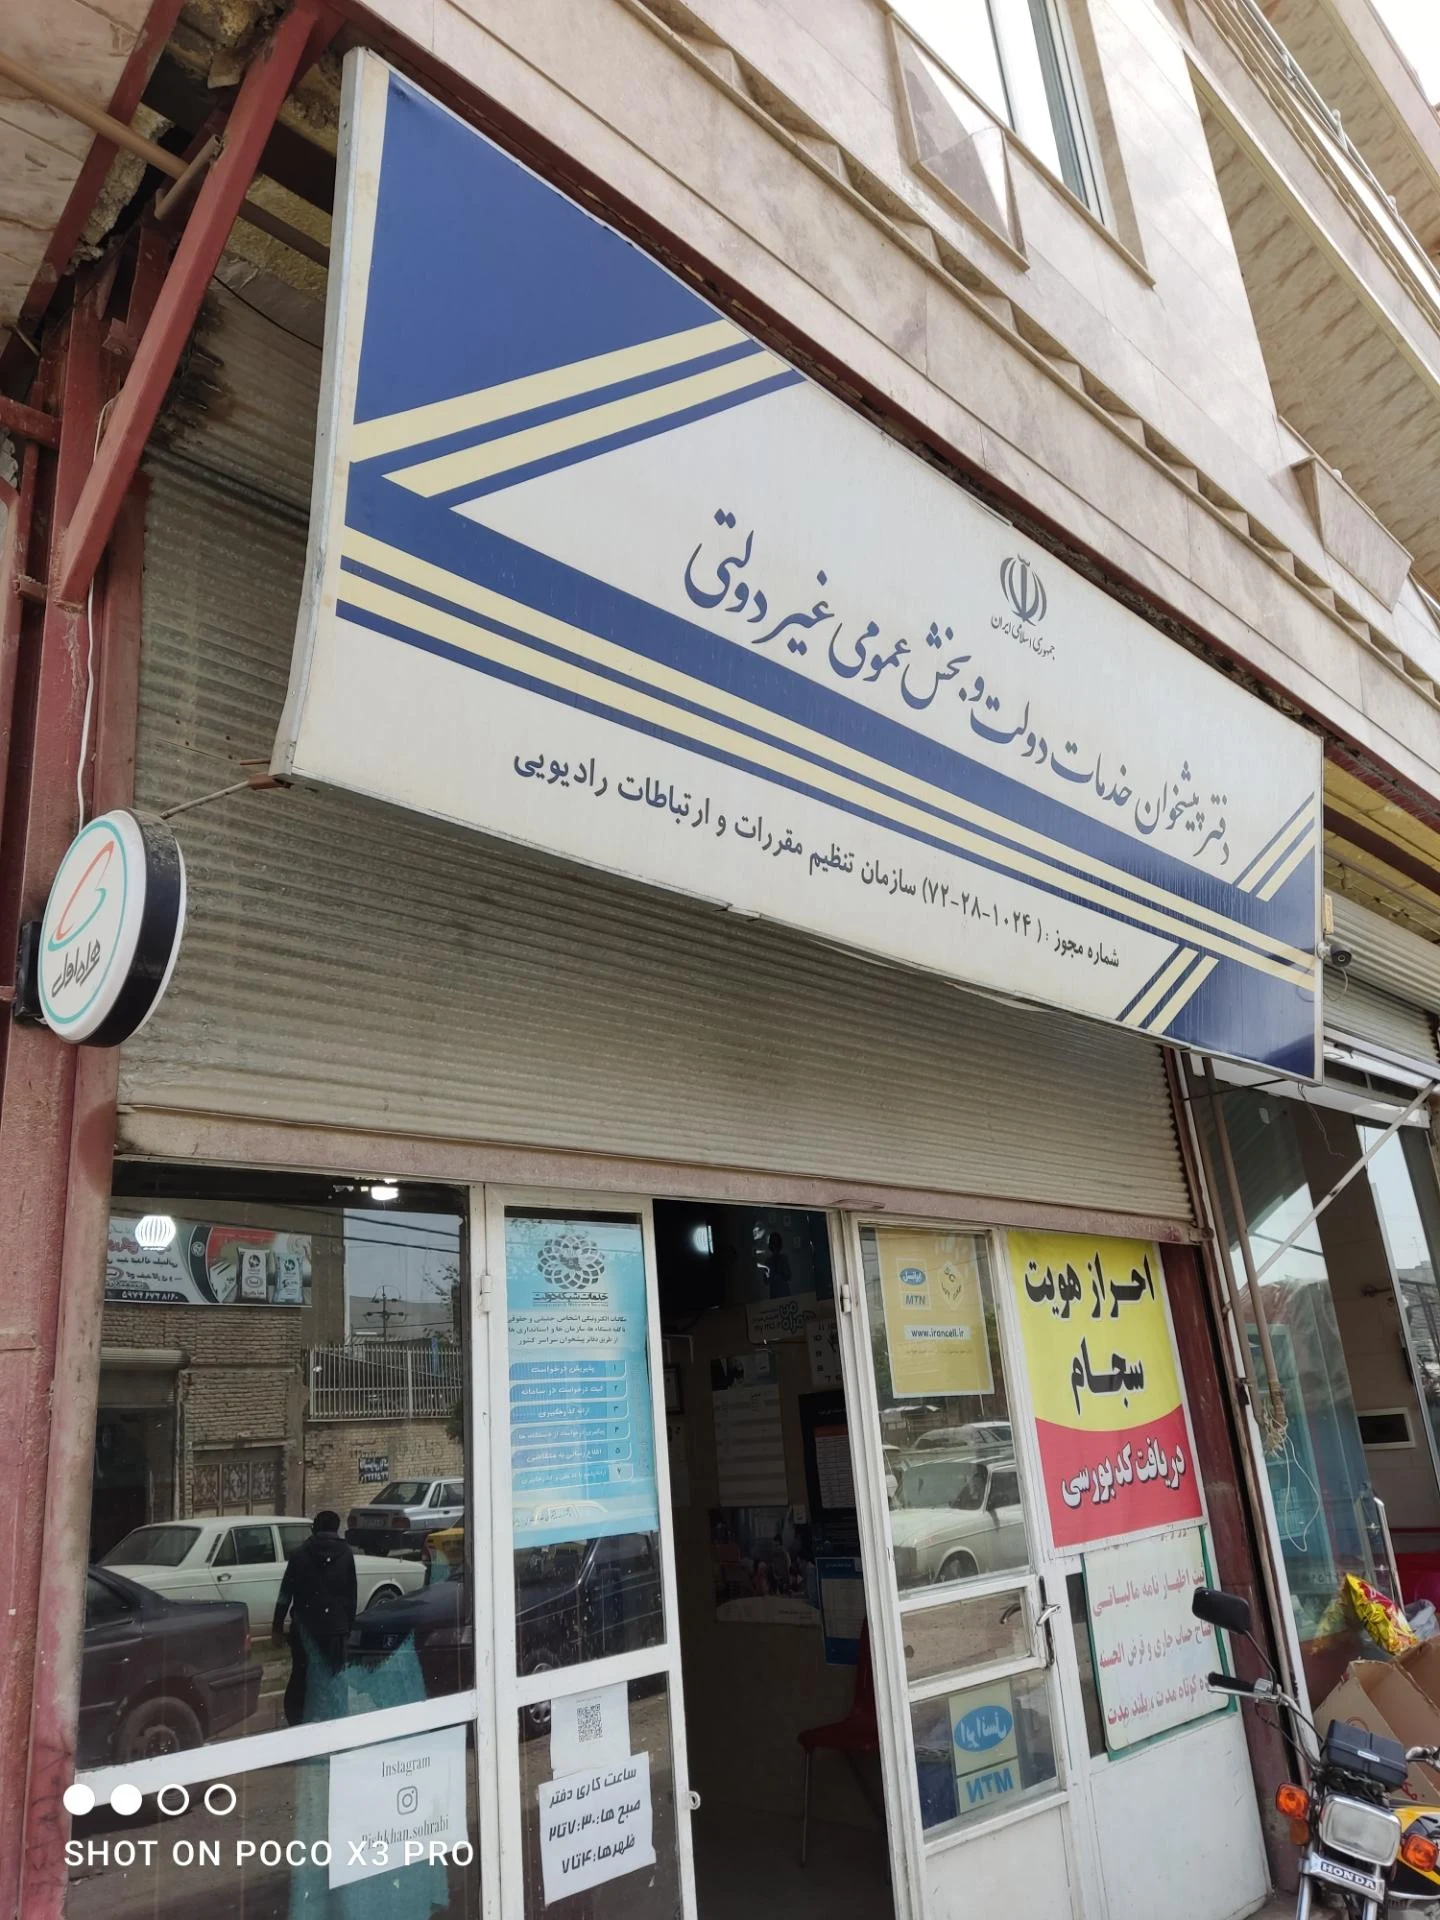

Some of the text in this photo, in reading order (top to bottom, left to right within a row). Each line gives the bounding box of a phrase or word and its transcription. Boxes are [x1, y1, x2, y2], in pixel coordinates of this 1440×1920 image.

[828, 621, 912, 683] عمومی
[991, 615, 1055, 661] جمهوری اسلامی ایران
[900, 621, 972, 710] بخش
[967, 676, 984, 701] و
[970, 695, 1049, 765] دولت
[513, 754, 608, 797] رادیویی
[1050, 740, 1133, 807] خدمات
[617, 776, 711, 828] ارتباطات
[1134, 760, 1205, 836] پیشخوان
[715, 813, 727, 837] و
[734, 816, 804, 857] مقررات
[1193, 794, 1230, 867] دفتر
[809, 843, 854, 876] تنظیم
[861, 860, 917, 896] سازمان
[1088, 942, 1120, 968] شماره
[905, 1294, 926, 1305] MTN
[1024, 1251, 1156, 1319] احراز هویت
[1070, 1336, 1145, 1417] سجام
[1062, 1437, 1186, 1508] دریافت کد بورسی
[381, 1756, 431, 1778] Instagram
[549, 1767, 637, 1809] ساعت کاری دفتر
[617, 1799, 641, 1825] صبح
[1321, 1862, 1376, 1891] HONDA
